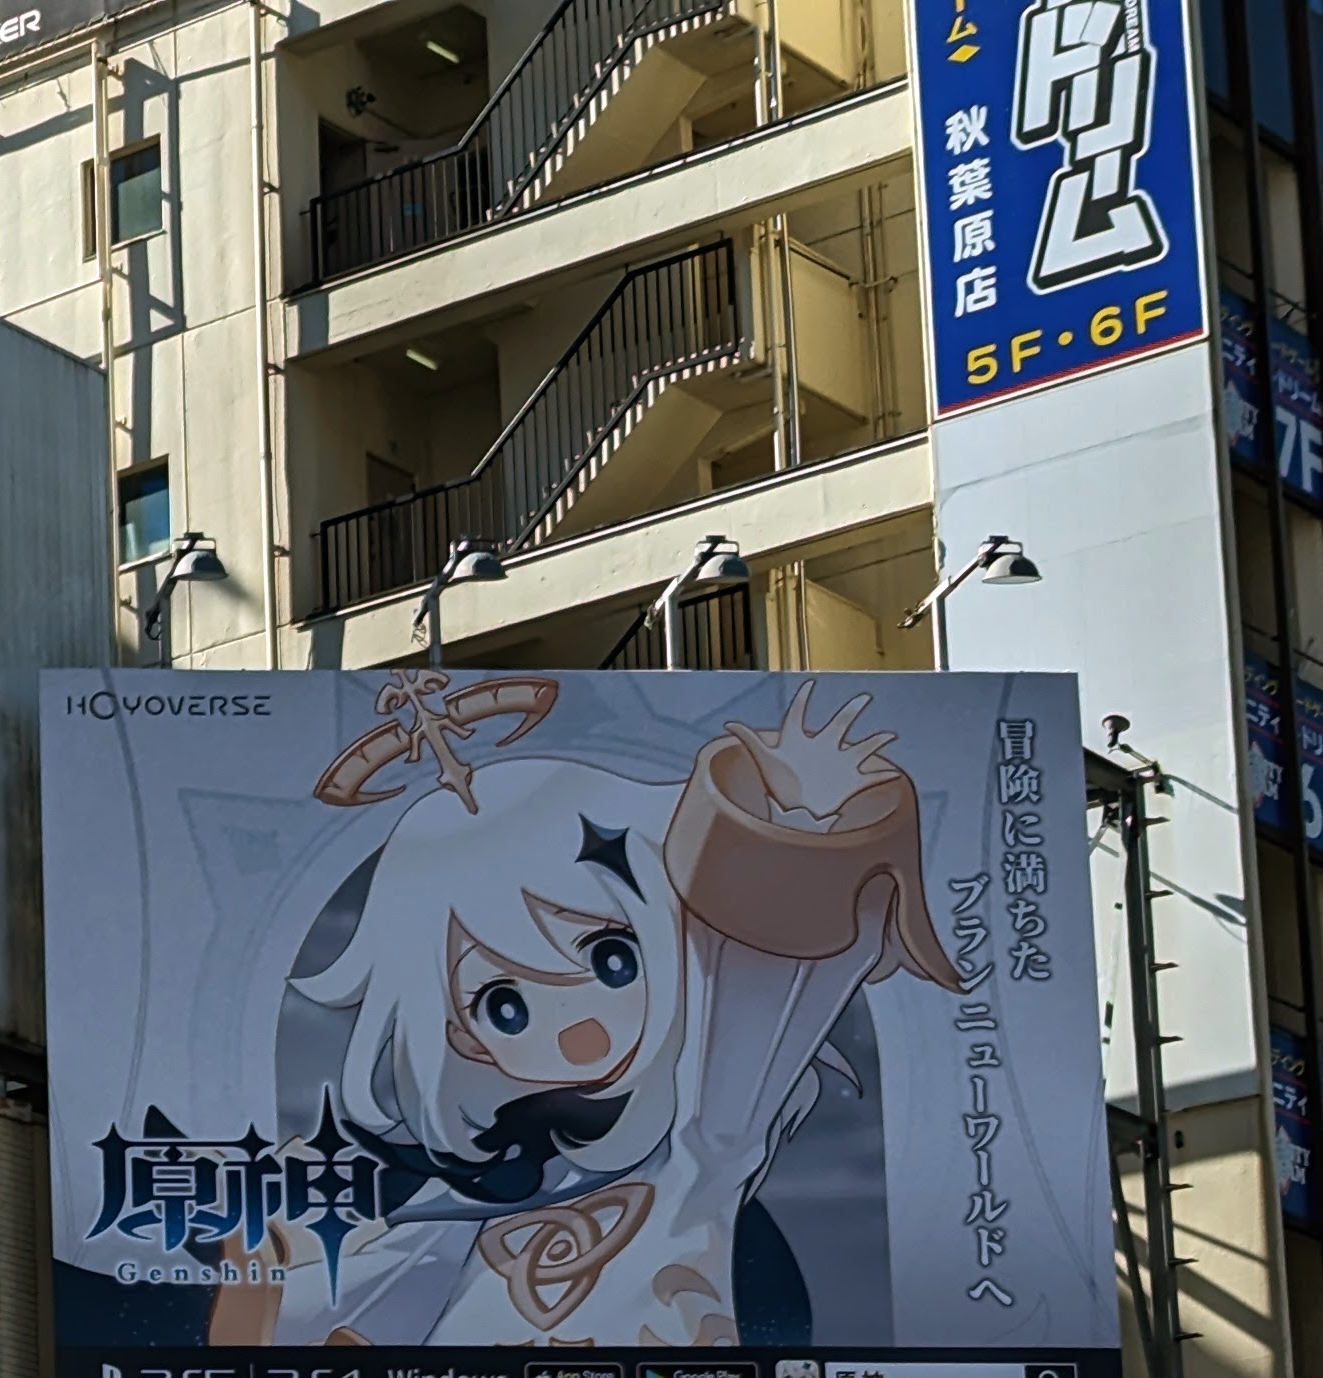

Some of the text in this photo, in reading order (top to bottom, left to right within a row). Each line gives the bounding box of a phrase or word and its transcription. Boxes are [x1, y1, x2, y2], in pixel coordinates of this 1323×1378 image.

[945, 104, 999, 318] 秋葉原店
[997, 719, 1052, 982] 冒険に満ちた
[85, 1082, 379, 1307] 原神
[949, 875, 1013, 1307] ブランニューワールドへ
[116, 1261, 288, 1284] Genshin
